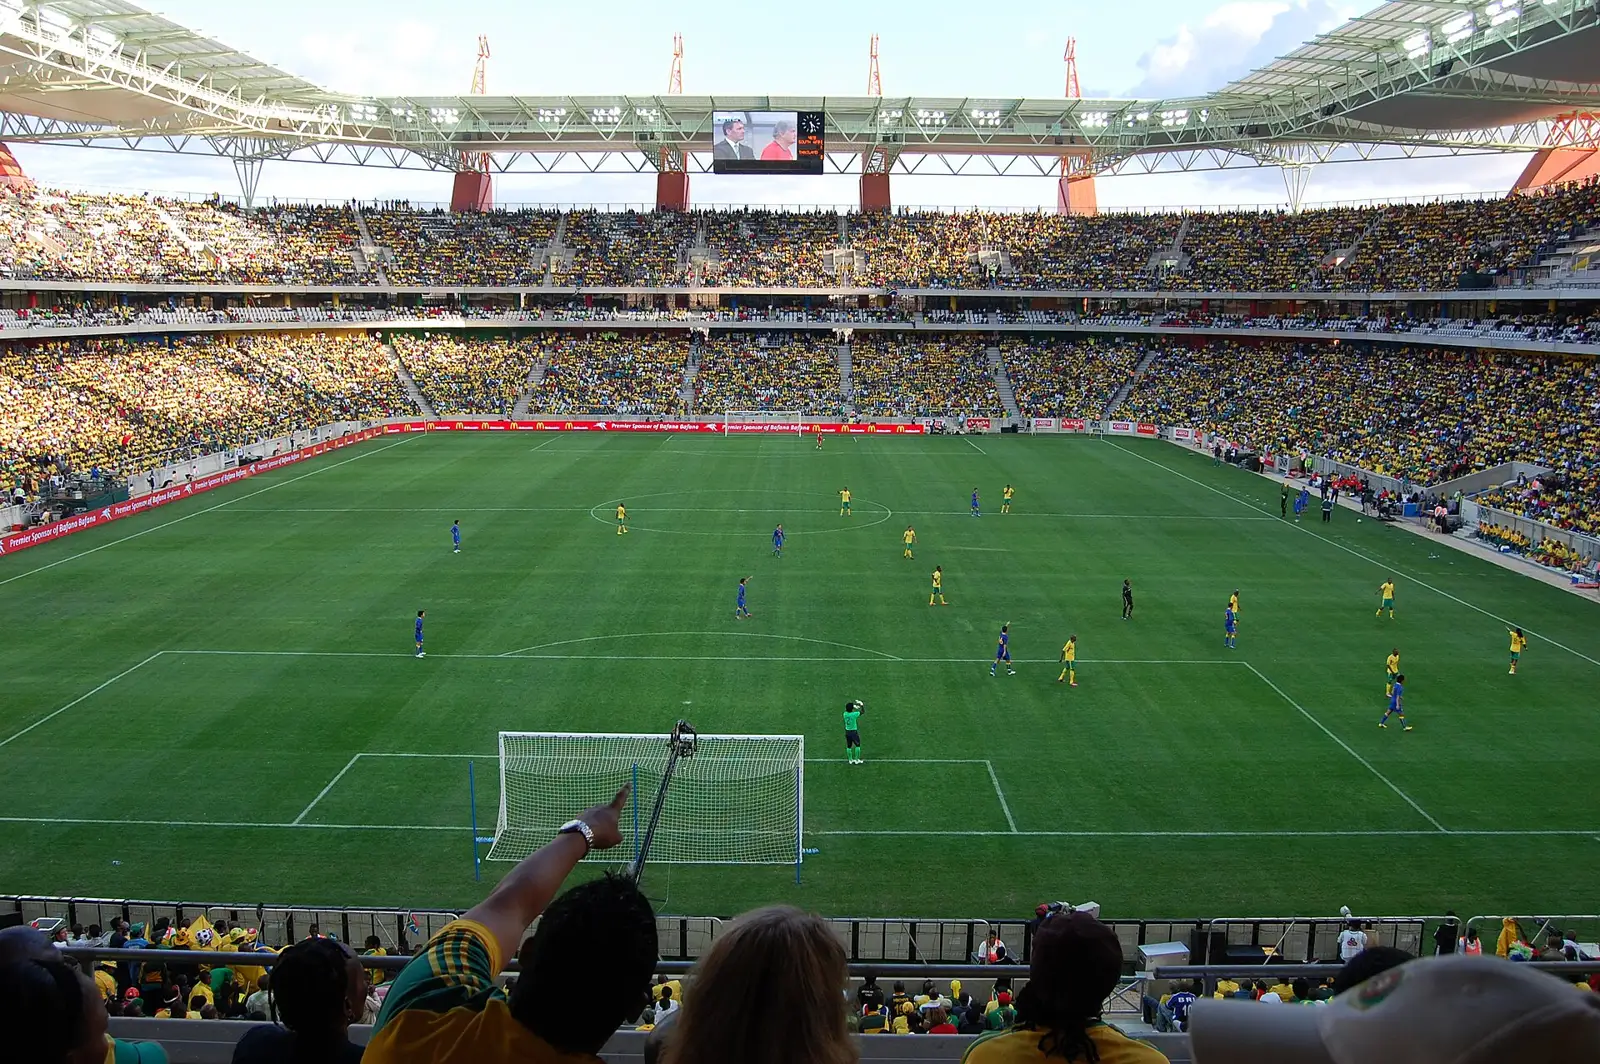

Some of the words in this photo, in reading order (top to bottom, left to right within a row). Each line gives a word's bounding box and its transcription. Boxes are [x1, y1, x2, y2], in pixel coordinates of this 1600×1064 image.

[114, 503, 131, 515] Premier
[131, 499, 147, 511] Sponsor
[9, 535, 31, 548] Premier
[31, 528, 53, 542] Sponsor
[52, 523, 60, 536] of
[59, 519, 77, 533] Bafana
[78, 515, 96, 527] Bafana
